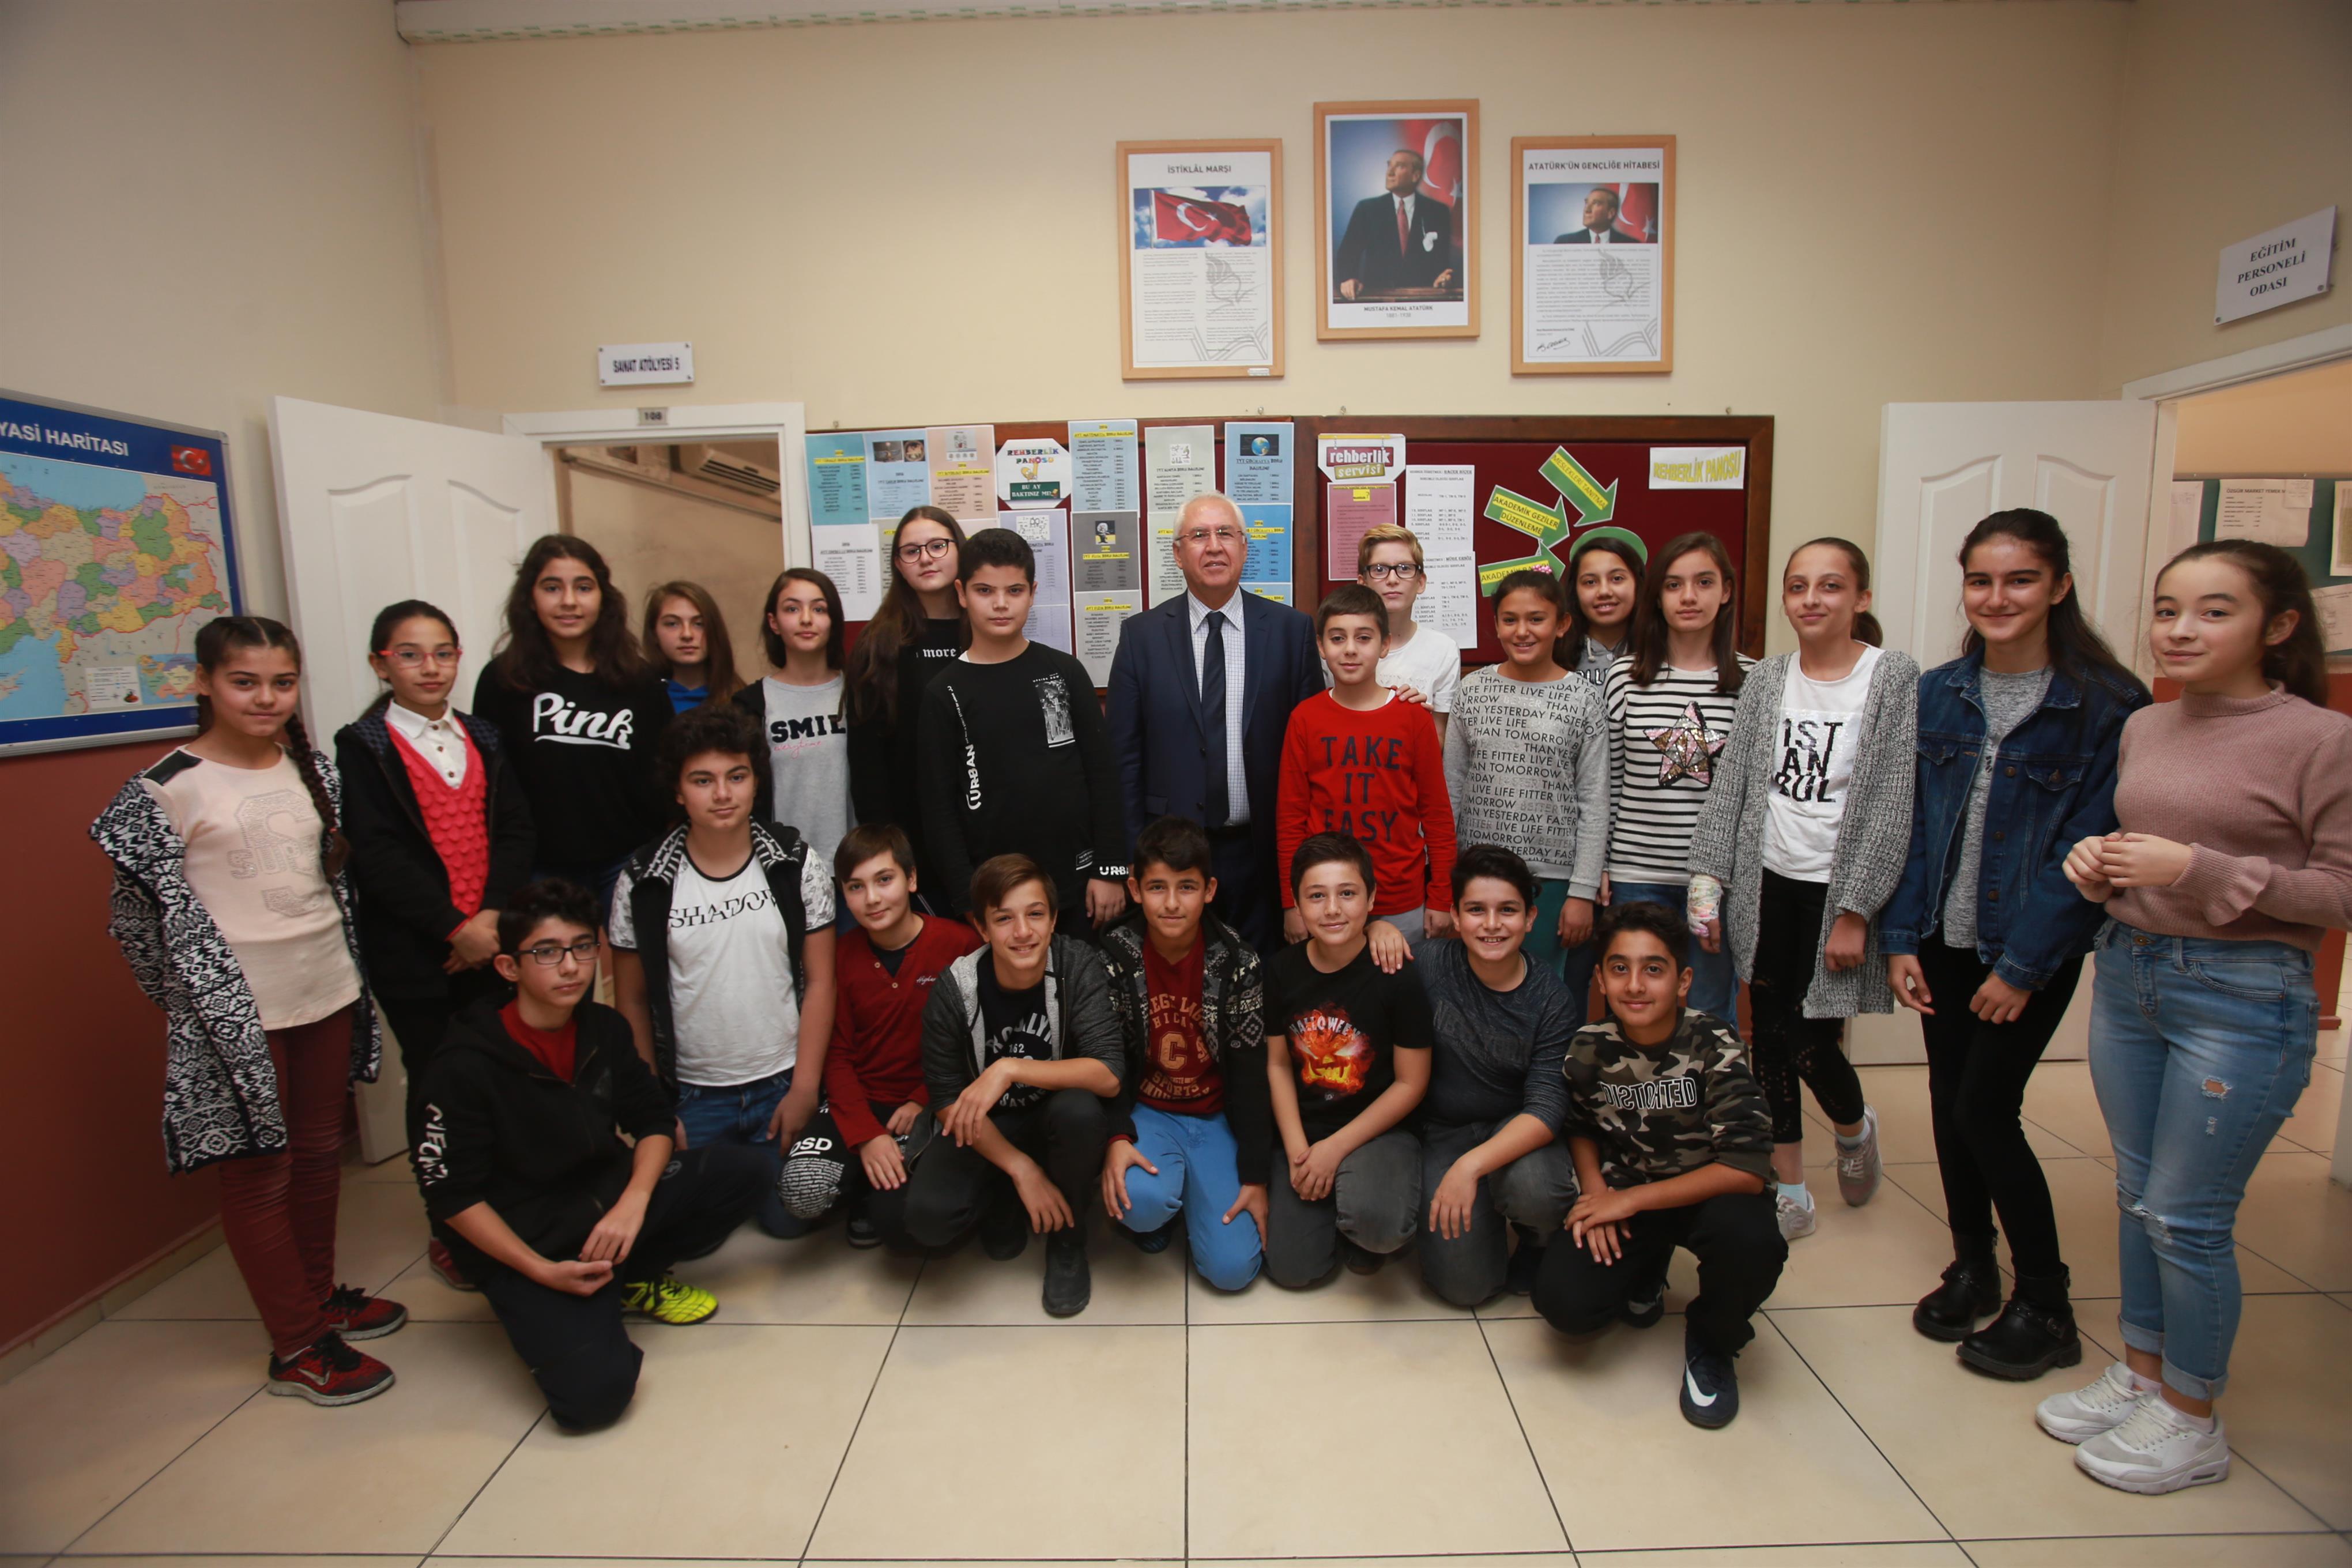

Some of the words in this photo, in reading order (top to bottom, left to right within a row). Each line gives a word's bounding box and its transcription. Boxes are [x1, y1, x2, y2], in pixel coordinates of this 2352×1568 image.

[1167, 164, 1204, 174] İSTİKLÂL
[1205, 165, 1232, 174] MARŞI
[1582, 160, 1621, 171] GENÇLİĞE
[1623, 159, 1660, 169] HİTABESİ
[2250, 238, 2296, 262] EĞİTİM
[2237, 250, 2305, 284] PERSONELİ
[2249, 277, 2287, 297] ODASI
[612, 359, 637, 373] SANAT
[638, 355, 673, 372] ATÖLYESİ
[44, 428, 129, 457] HARİTASI
[1007, 447, 1060, 456] REHBERLİK
[1329, 449, 1390, 463] rehberlik
[1338, 464, 1381, 477] servisi
[1653, 457, 1703, 483] REHBERLİK
[1705, 450, 1741, 483] PANOSU
[1581, 483, 1607, 510] TANITMA
[1493, 495, 1531, 516] AKADEMİK
[1531, 510, 1559, 529] GEZİLER
[1500, 510, 1543, 535] DÜZENLEME
[922, 648, 957, 658] more
[1483, 685, 1516, 693] FITTER
[1521, 687, 1544, 697] LIVE
[1548, 692, 1570, 702] LIFE
[1546, 700, 1575, 714] THAN
[533, 692, 635, 749] Pink
[1480, 715, 1502, 725] LIVE
[1510, 718, 1527, 728] LIFE
[1484, 705, 1546, 719] YESTERDAY
[1549, 711, 1586, 729] FASTER
[770, 714, 846, 743] SMIL
[1473, 727, 1501, 737] THAN
[1505, 729, 1571, 747] TOMORROW
[1320, 735, 1403, 770] TAKE
[1524, 743, 1556, 755] THAN
[1491, 751, 1526, 763] FITTER
[1530, 755, 1553, 766] LIVE
[1490, 762, 1562, 778] TOMORROW
[1344, 772, 1375, 804] IT
[1472, 784, 1491, 795] LIVE
[1494, 786, 1516, 797] LIFE
[1519, 789, 1554, 802] FITTER
[1324, 808, 1399, 843] EASY
[1483, 808, 1543, 823] YESTERDAY
[1546, 815, 1577, 826] FASTER
[1469, 829, 1535, 845] TOMORROW
[1495, 821, 1518, 832] LIVE
[1521, 824, 1543, 835] LIFE
[1099, 866, 1129, 876] URB
[1289, 1015, 1361, 1038] HALLOWEEN
